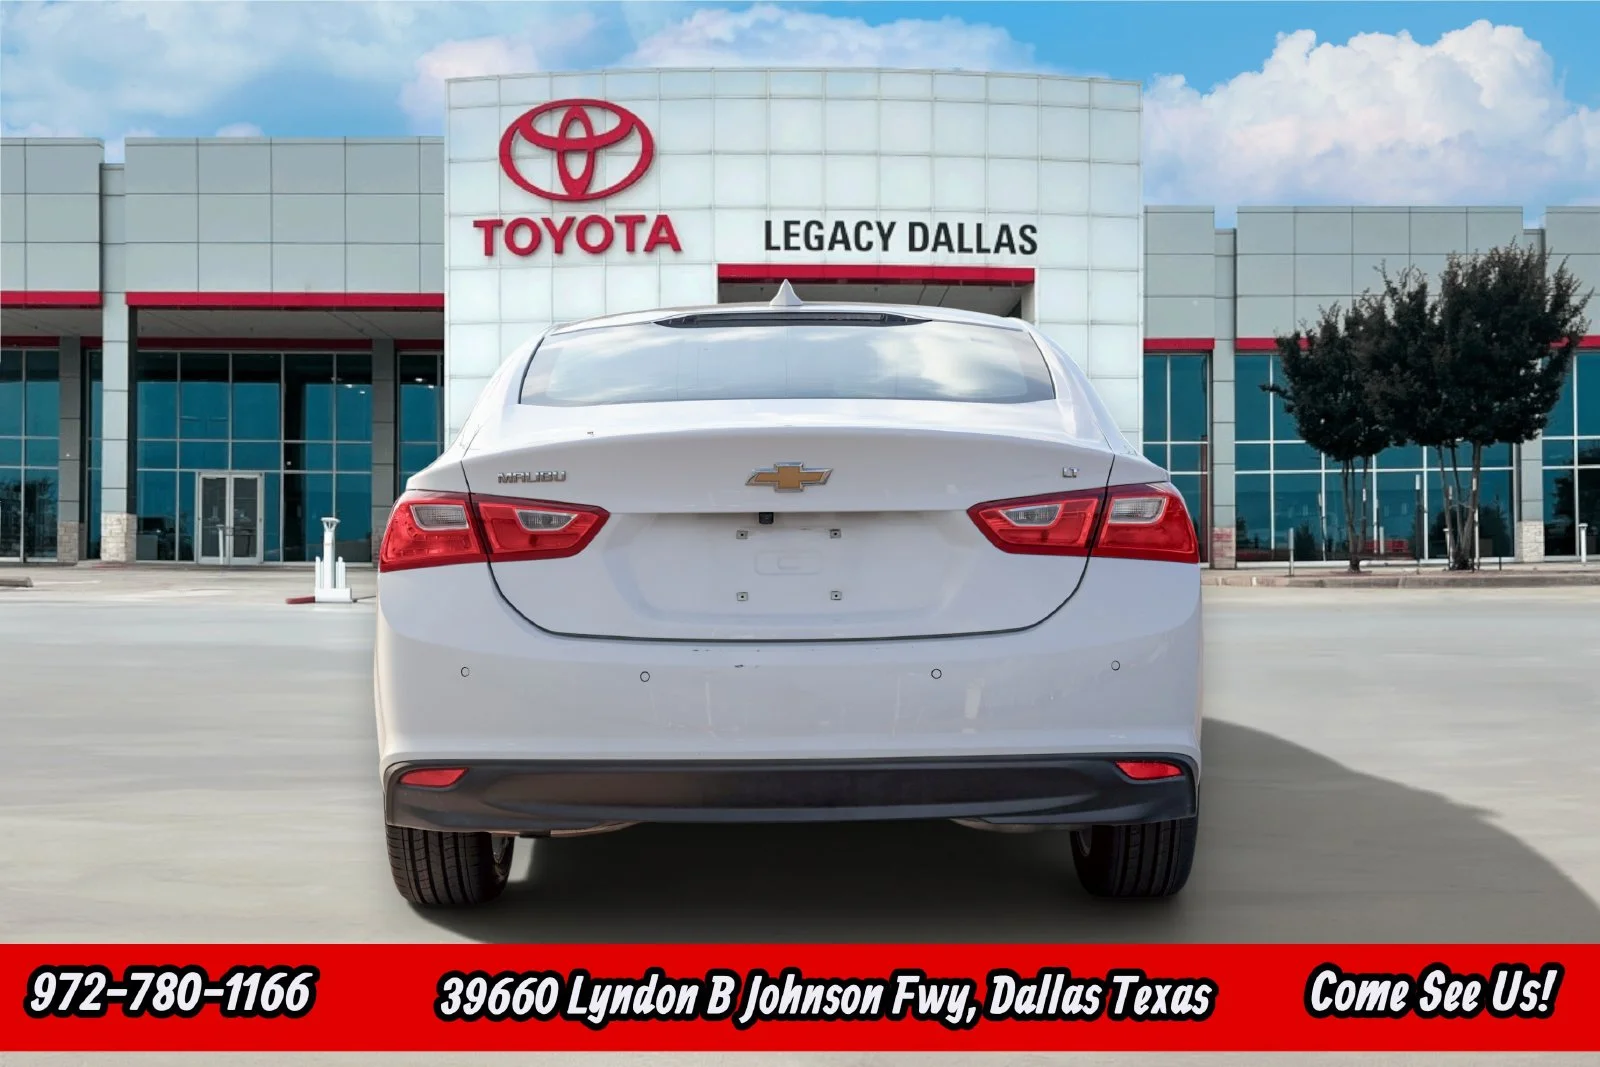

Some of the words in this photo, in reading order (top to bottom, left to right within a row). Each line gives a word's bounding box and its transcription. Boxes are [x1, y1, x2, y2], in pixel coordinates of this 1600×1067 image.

[473, 214, 682, 257] TOYOTA
[764, 220, 896, 252] LEGACY
[908, 222, 1038, 255] DALLAS
[497, 470, 567, 484] MALIBU
[1062, 466, 1080, 478] LT
